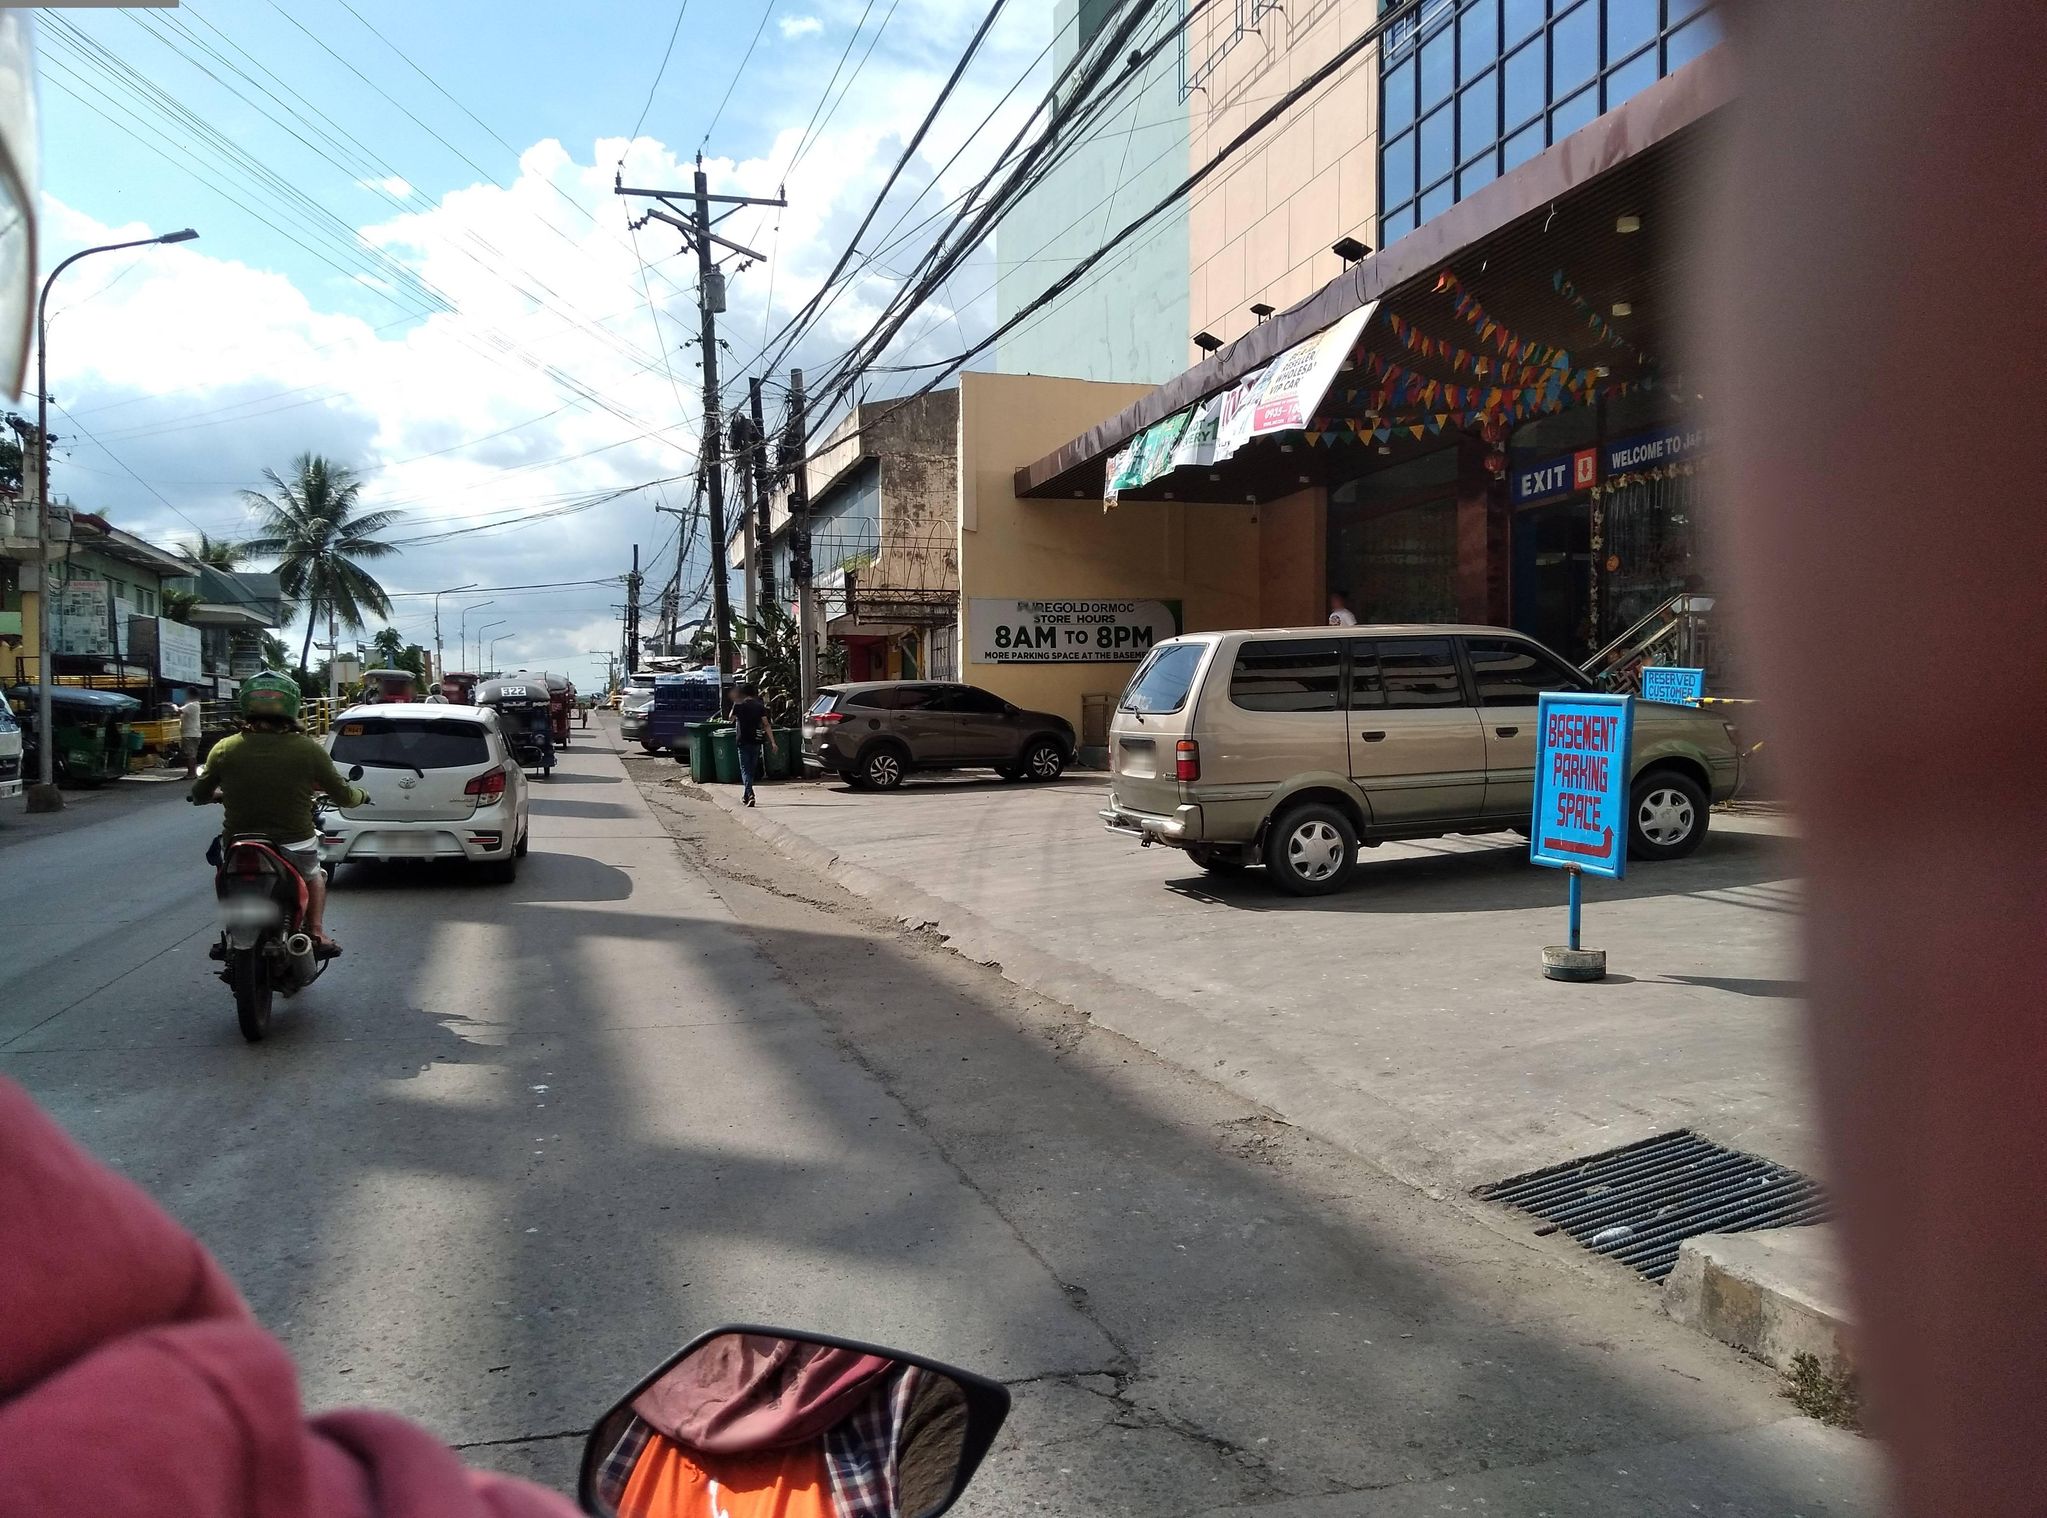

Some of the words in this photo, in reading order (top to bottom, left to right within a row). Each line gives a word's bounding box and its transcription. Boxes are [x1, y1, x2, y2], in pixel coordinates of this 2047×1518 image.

[1283, 376, 1304, 391] CAR
[1612, 440, 1663, 469] WELCOME
[1665, 435, 1681, 454] TO
[1522, 464, 1566, 497] EXIT
[1091, 603, 1135, 613] ORMOC
[1033, 614, 1071, 624] STORE
[1077, 614, 1116, 624] HOURS
[994, 626, 1057, 649] 8AM
[1064, 630, 1089, 644] TO
[1097, 626, 1153, 649] 8PM
[984, 651, 1010, 659] MORE
[1011, 651, 1050, 659] PARKING
[1051, 651, 1079, 659] SPACE
[1081, 651, 1093, 659] AT
[1094, 651, 1111, 659] THE
[1648, 672, 1696, 687] RESERVED
[503, 687, 525, 696] 322
[1648, 685, 1694, 699] CUSTOMER
[1548, 713, 1619, 754] BASEMENT
[1553, 752, 1609, 793] PARKING
[1556, 792, 1602, 832] SPACE
